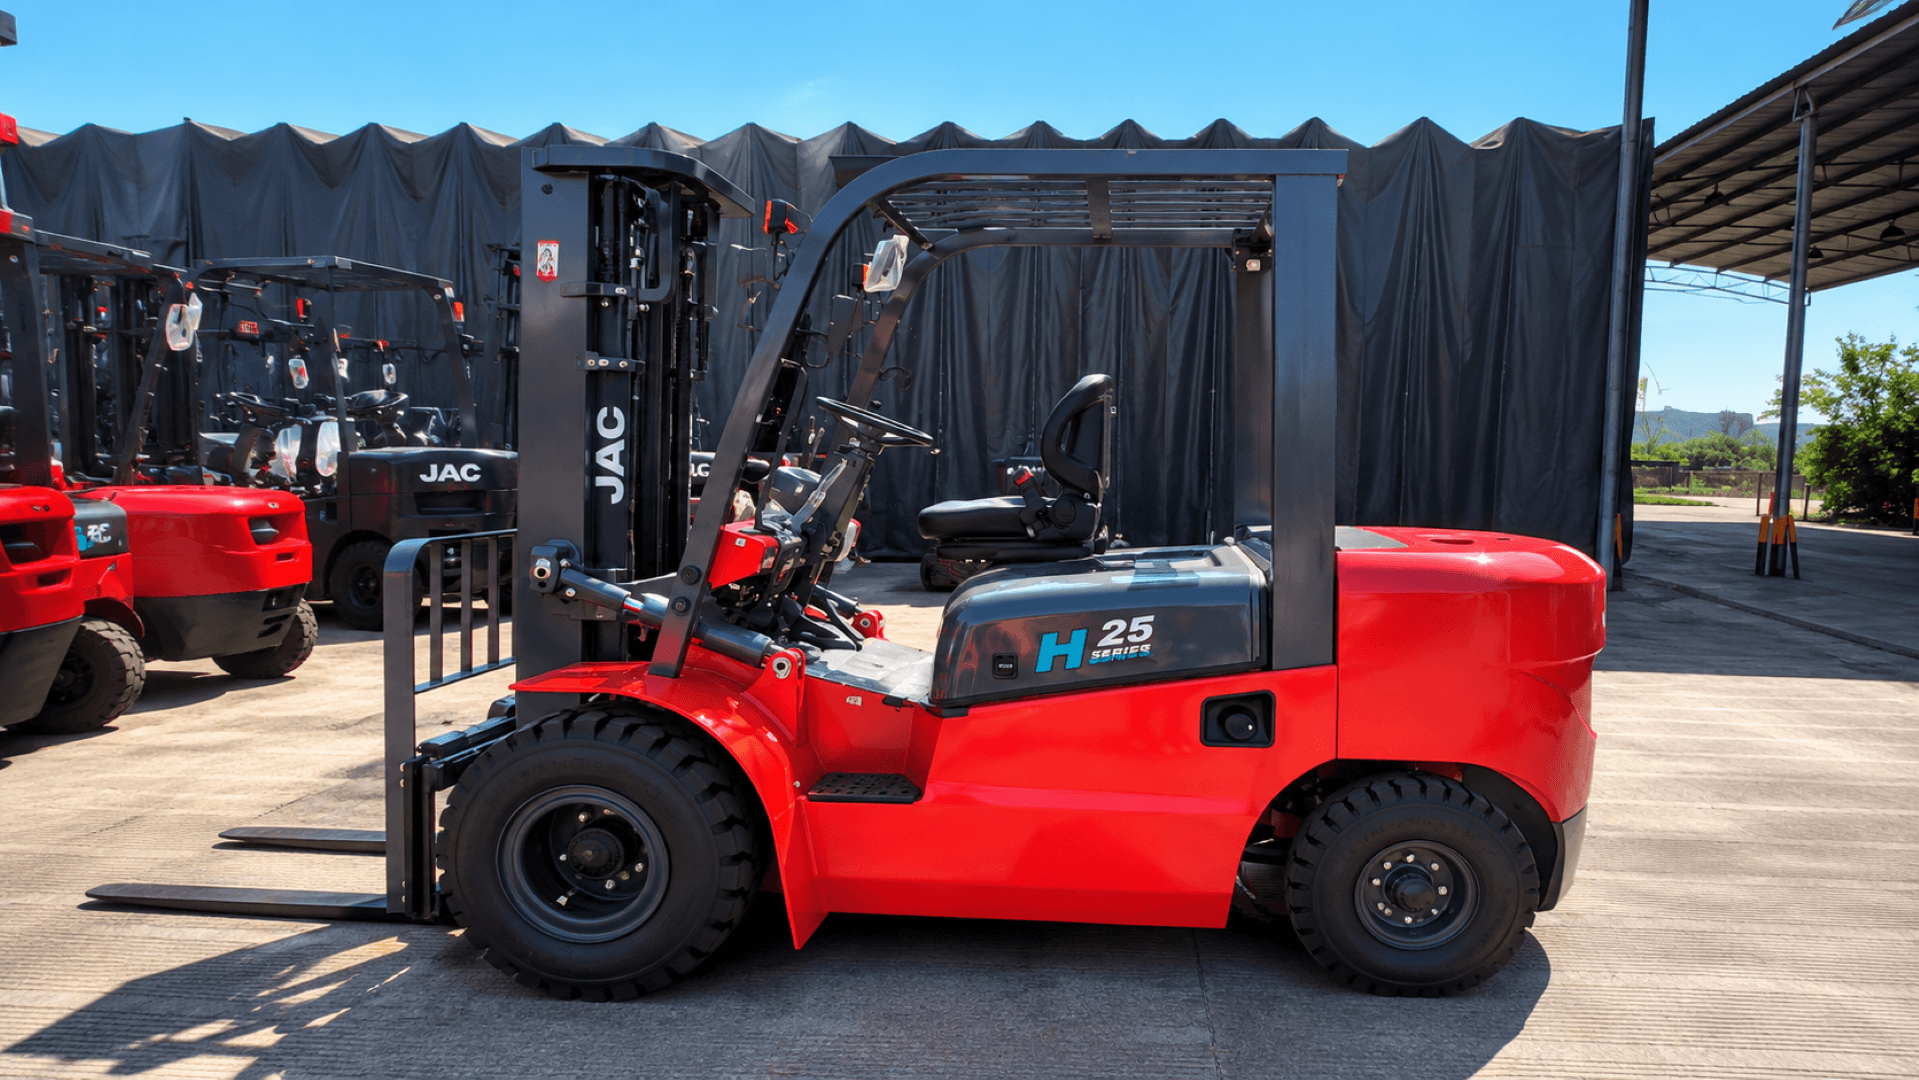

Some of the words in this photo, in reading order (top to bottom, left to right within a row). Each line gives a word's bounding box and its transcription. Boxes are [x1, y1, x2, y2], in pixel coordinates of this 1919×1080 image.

[419, 463, 482, 483] JAC
[595, 405, 626, 505] JAC
[1035, 628, 1089, 673] H
[1096, 614, 1155, 648] 25
